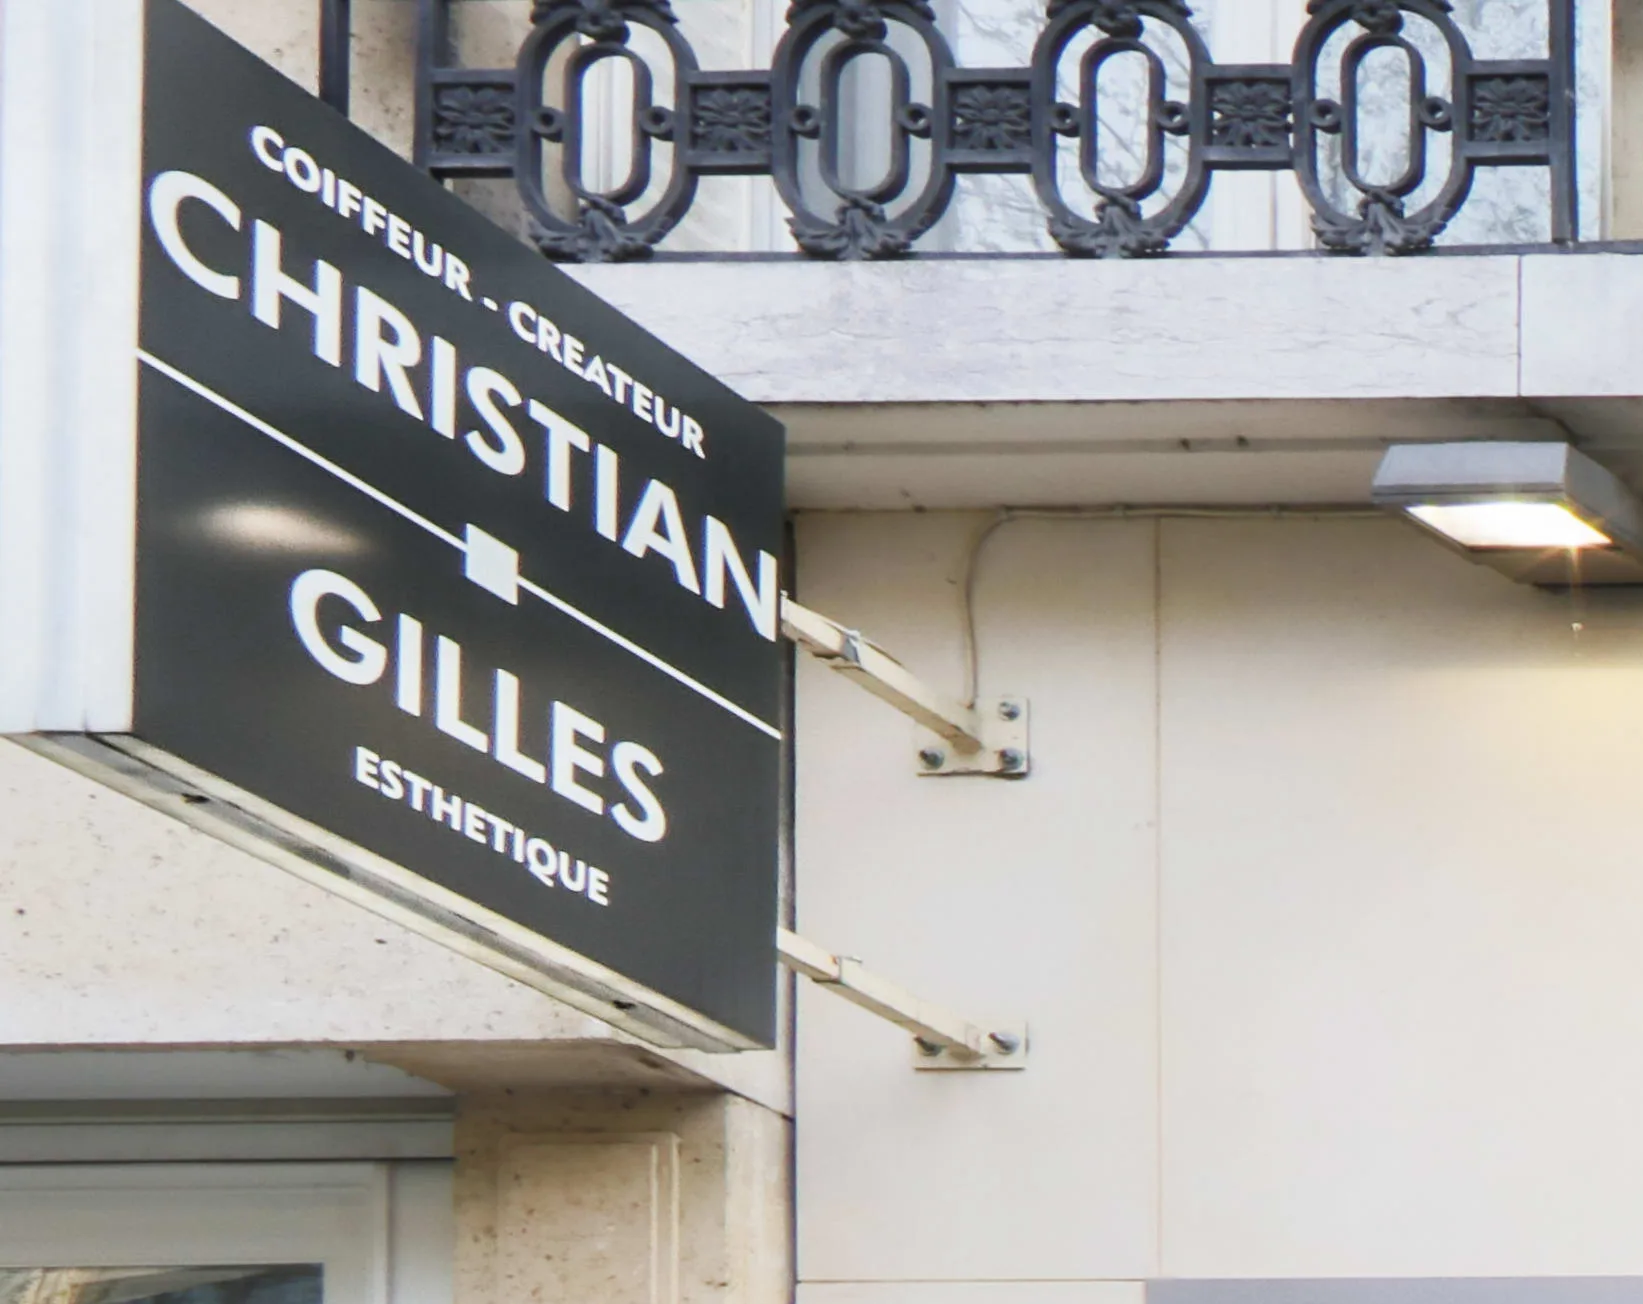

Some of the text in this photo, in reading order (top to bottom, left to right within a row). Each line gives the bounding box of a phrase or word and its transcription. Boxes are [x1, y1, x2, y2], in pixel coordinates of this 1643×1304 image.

[149, 170, 778, 643] CHRISTIAN
[252, 125, 705, 459] COIFFEUR CREATEUR
[290, 567, 668, 843] GILLES
[354, 745, 610, 906] ESTHETIQUE
